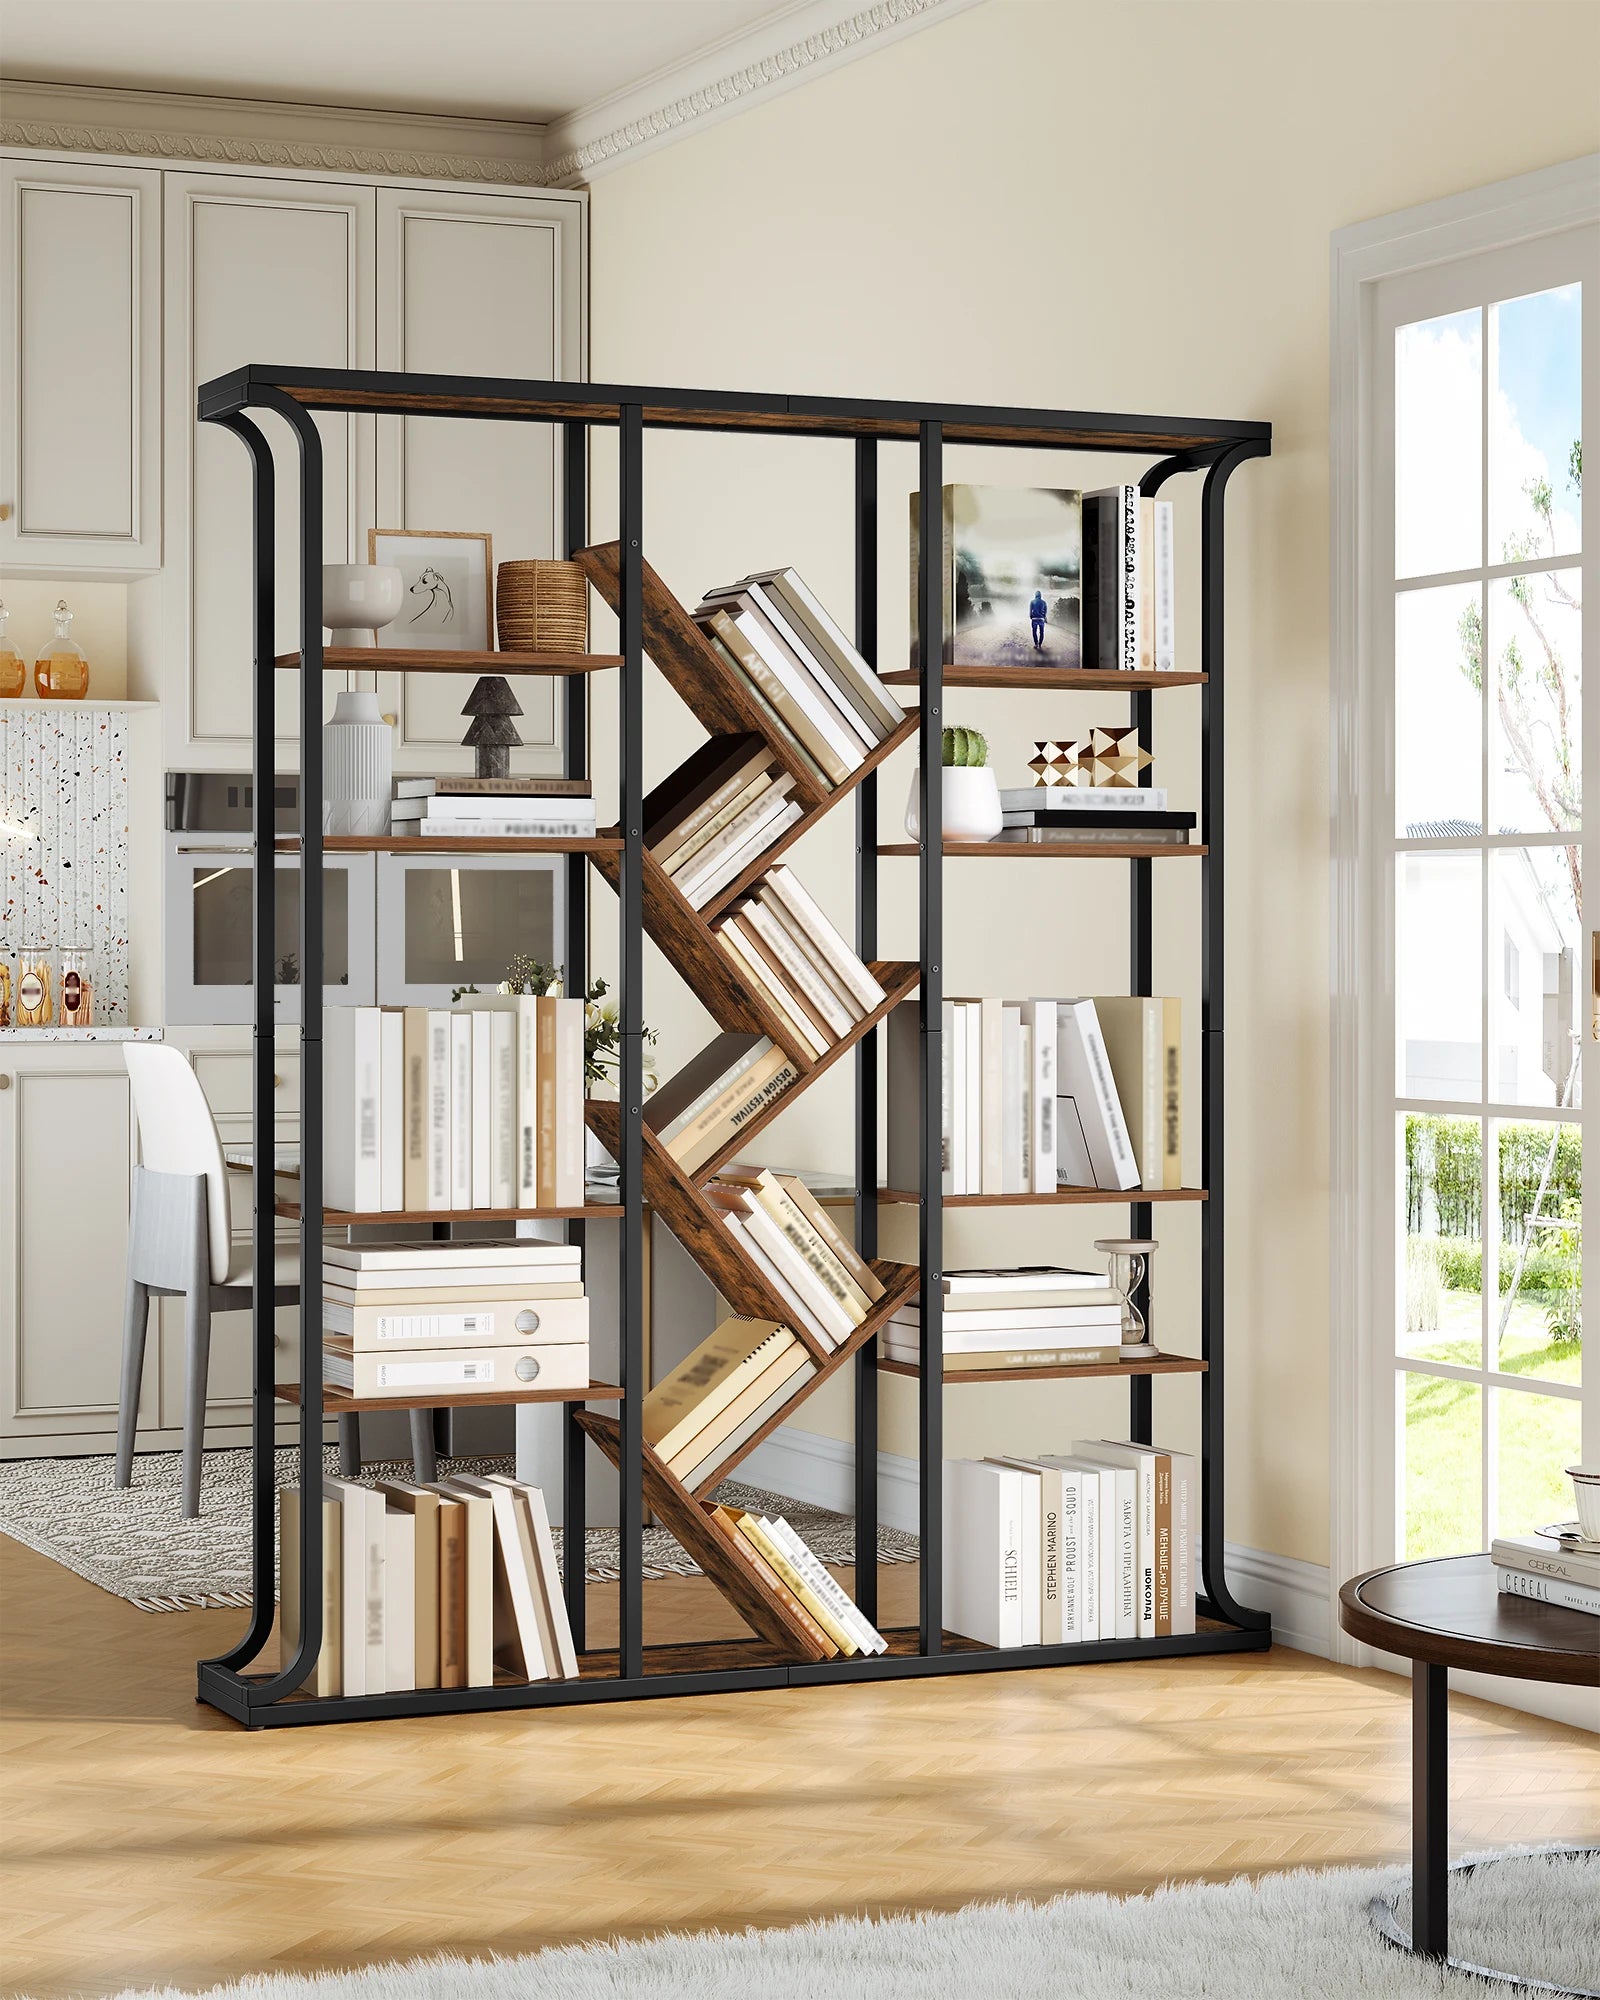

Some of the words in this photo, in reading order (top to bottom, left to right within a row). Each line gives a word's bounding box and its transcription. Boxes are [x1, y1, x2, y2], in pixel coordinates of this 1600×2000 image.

[763, 1067, 792, 1097] DESIGN
[730, 1093, 765, 1126] FESTIVAL
[1066, 1486, 1077, 1515] SQUID
[1047, 1512, 1057, 1552] MARINO
[1123, 1499, 1132, 1538] ЗАБОТА
[1065, 1536, 1076, 1572] PROUST
[1123, 1541, 1132, 1550] О
[1005, 1549, 1018, 1602] SCHIELE
[1047, 1554, 1057, 1600] STEPHEN
[1122, 1552, 1132, 1618] ПРЕДАННЫХ
[1528, 1559, 1571, 1577] CEREAL
[1143, 1568, 1152, 1621] ШОКОЛАД
[1159, 1586, 1169, 1620] ЛУЧШЕ
[1505, 1573, 1549, 1600] CEREAL
